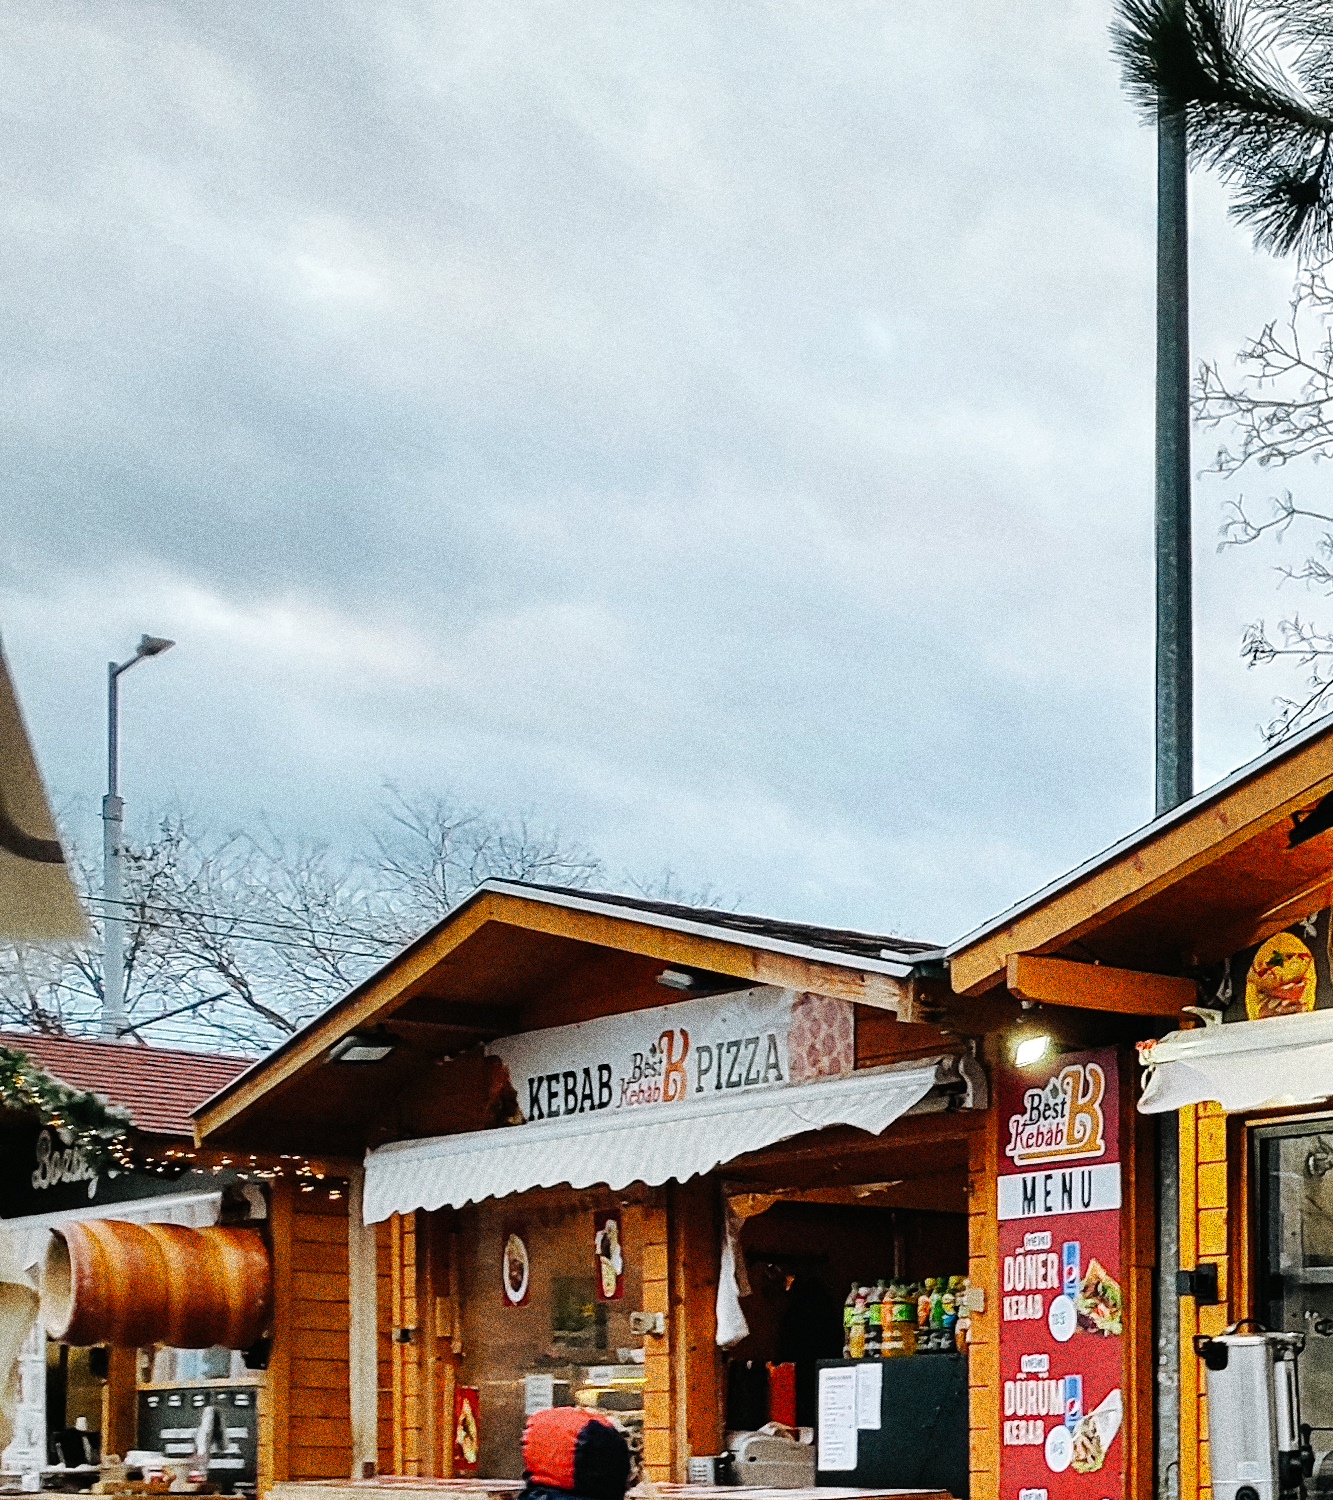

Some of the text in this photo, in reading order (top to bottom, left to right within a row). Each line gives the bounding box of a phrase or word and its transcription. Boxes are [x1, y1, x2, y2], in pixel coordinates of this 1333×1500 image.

[527, 1033, 783, 1121] KEBAB PIZZA
[631, 1052, 663, 1084] Best
[616, 1078, 661, 1109] Kebab
[1027, 1089, 1066, 1126] Best
[1011, 1118, 1064, 1155] Kebab
[1020, 1169, 1092, 1216] MENU
[1003, 1246, 1060, 1293] DÖNER
[1003, 1295, 1043, 1322] KEBAB
[1004, 1372, 1065, 1417] DÜRÜM
[1003, 1420, 1044, 1446] KEBAB
